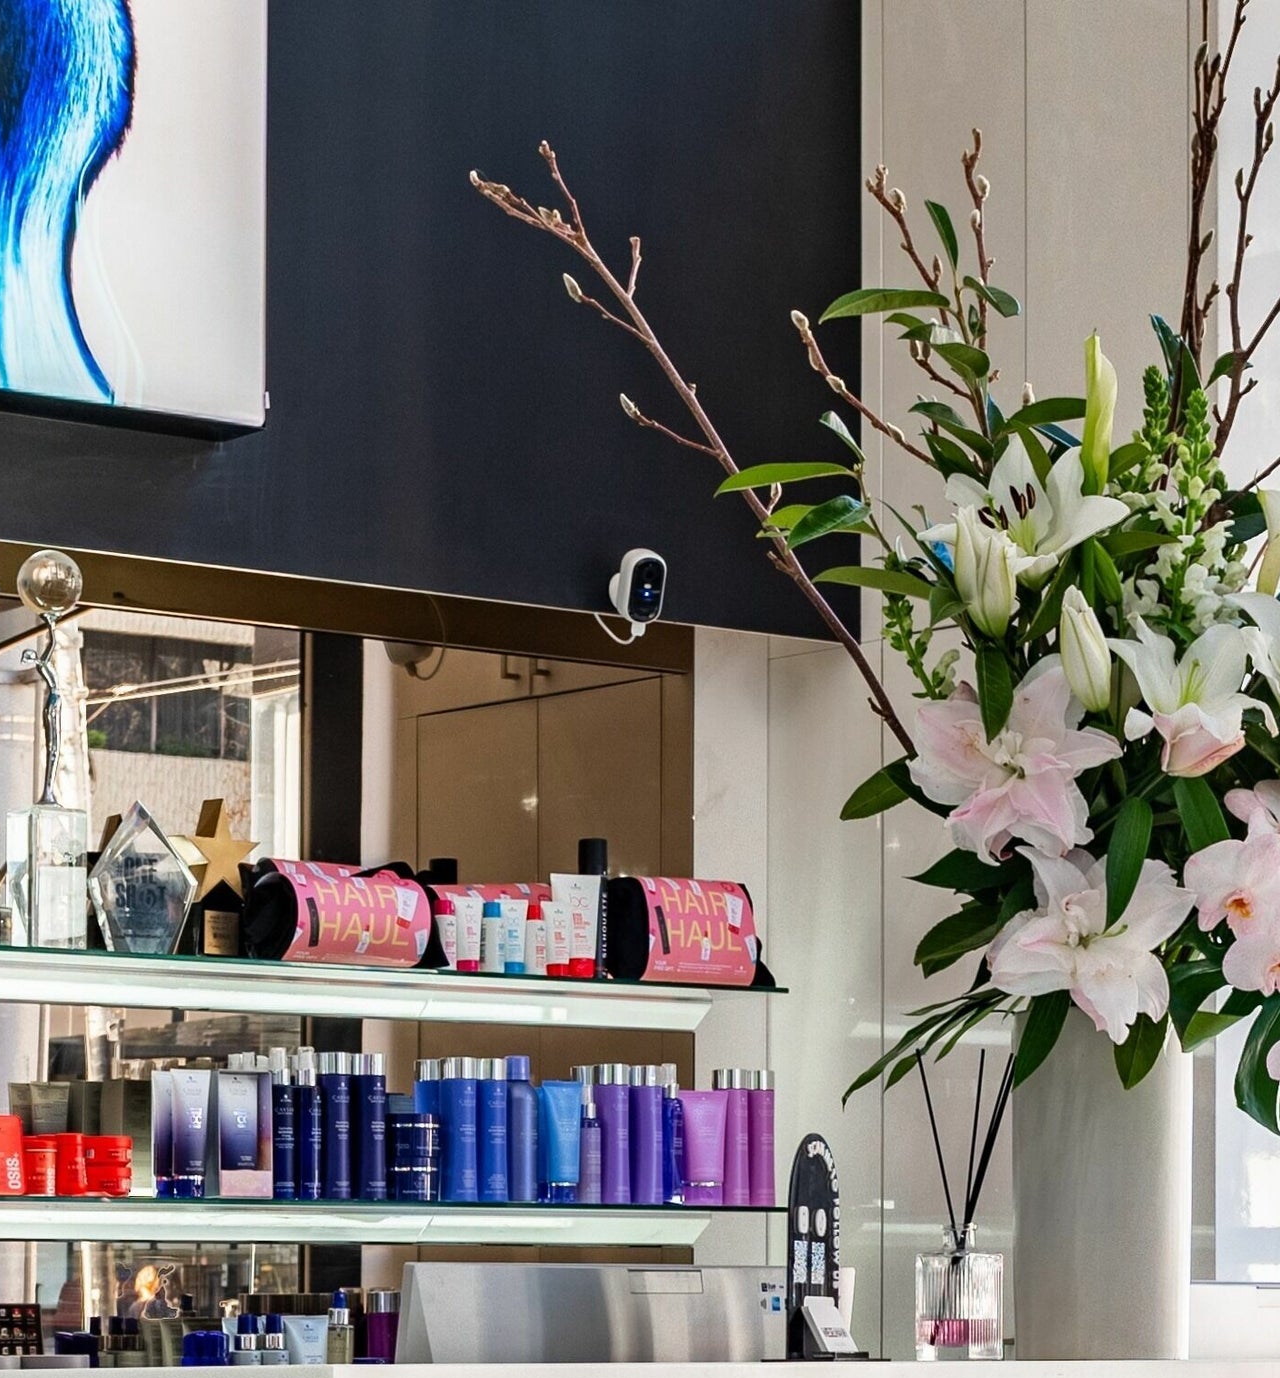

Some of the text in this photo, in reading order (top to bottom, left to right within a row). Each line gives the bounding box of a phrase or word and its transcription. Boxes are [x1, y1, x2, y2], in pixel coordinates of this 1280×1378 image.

[313, 880, 399, 910] HAIR
[660, 885, 728, 918] HAIR
[319, 911, 410, 947] HAUL
[601, 892, 609, 960] SILHOUETTE
[667, 918, 743, 951] HAUL
